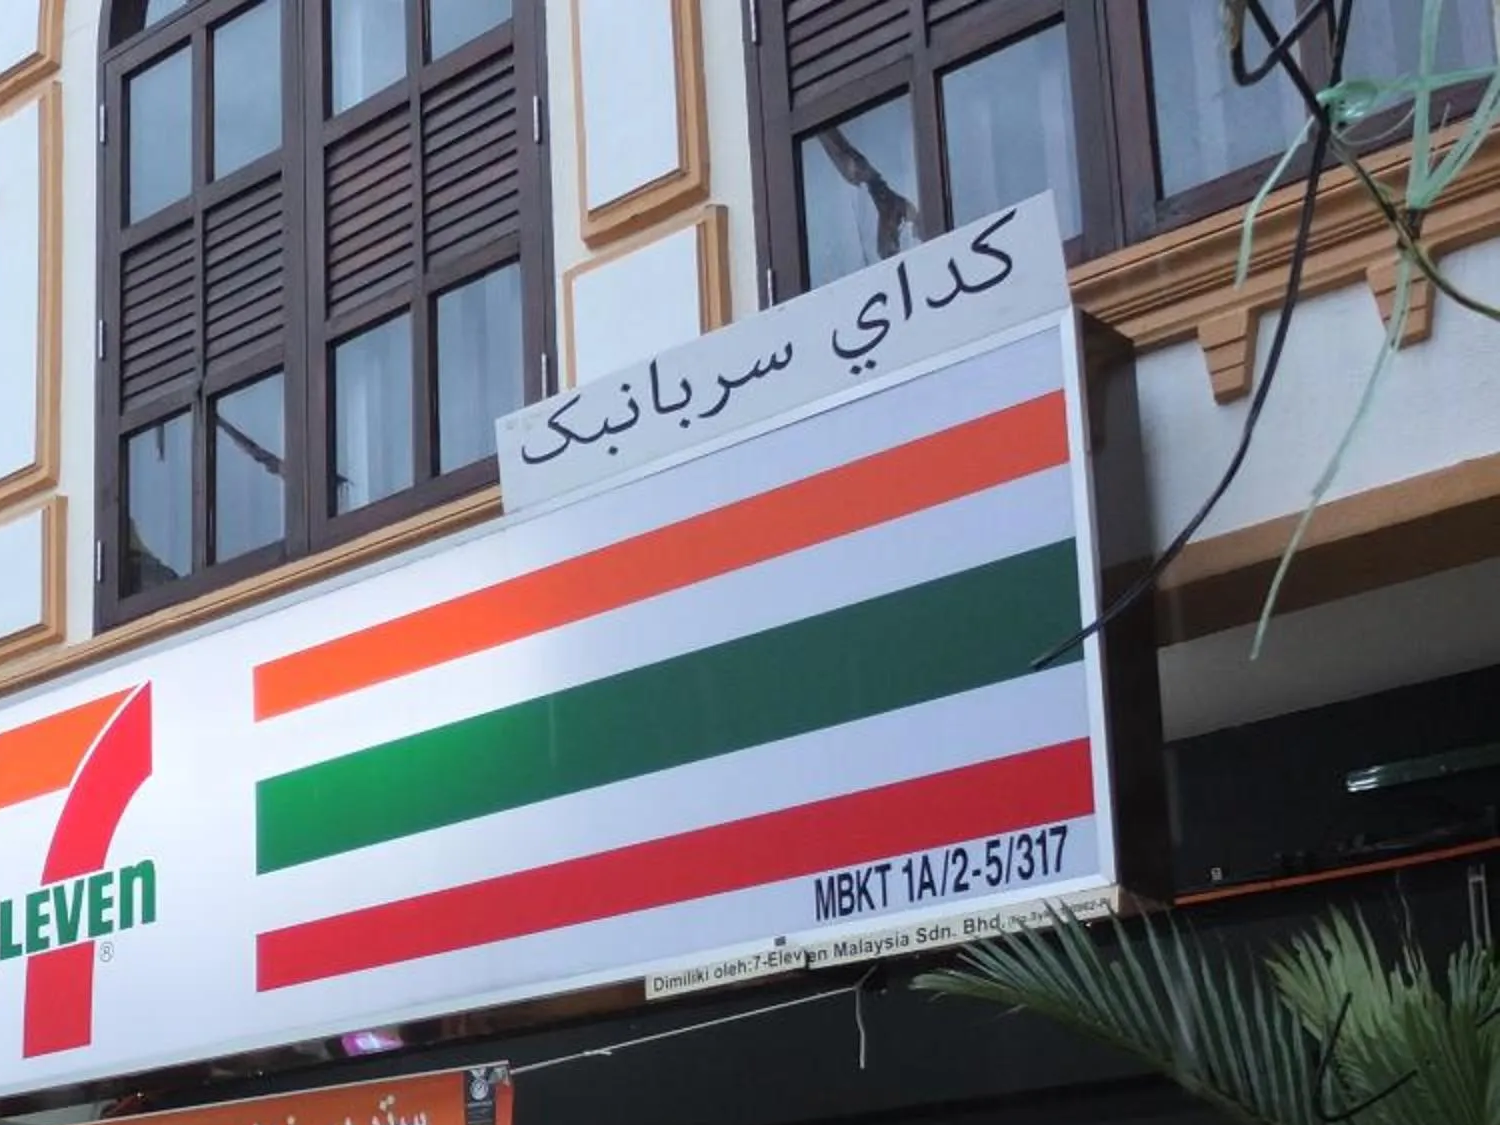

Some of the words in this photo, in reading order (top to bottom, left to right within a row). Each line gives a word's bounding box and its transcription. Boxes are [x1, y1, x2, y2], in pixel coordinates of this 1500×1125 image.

[815, 862, 891, 922] MBKT
[901, 825, 1069, 902] 1A/2-5/317
[653, 967, 709, 993] Dimiliki
[833, 931, 910, 963] Malaysia
[915, 924, 957, 944] Sdn.
[963, 913, 1006, 936] Bhd.
